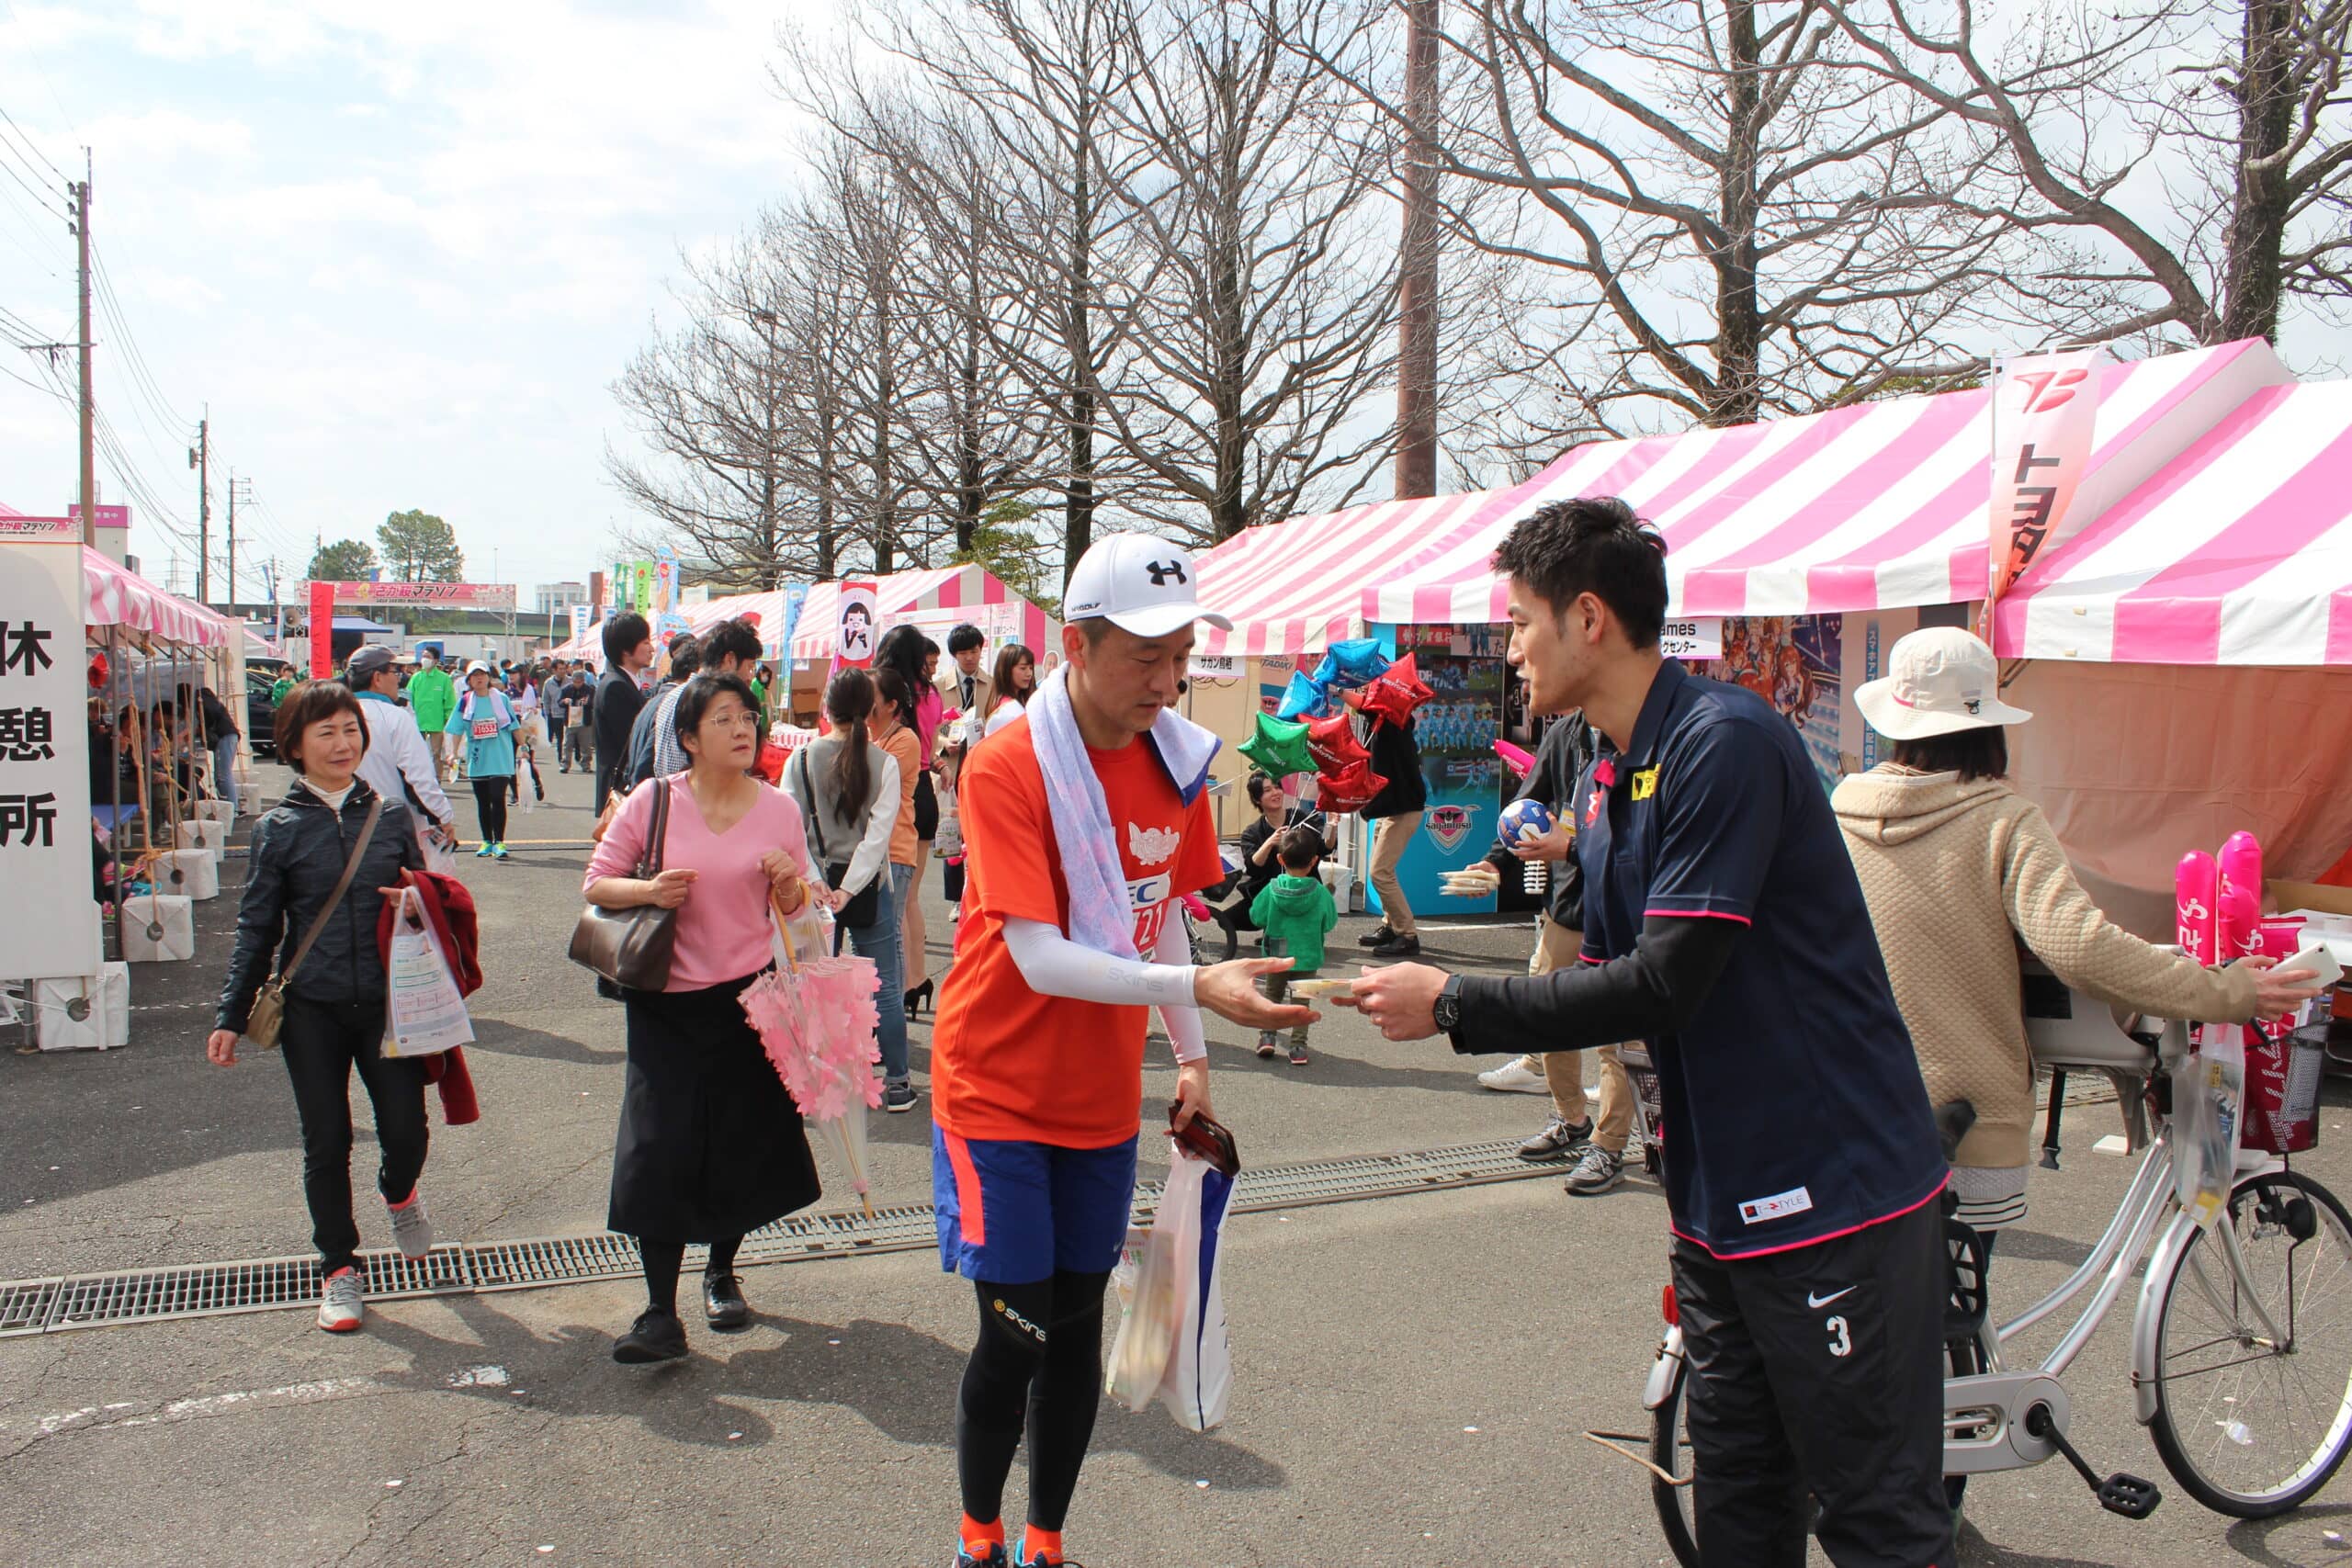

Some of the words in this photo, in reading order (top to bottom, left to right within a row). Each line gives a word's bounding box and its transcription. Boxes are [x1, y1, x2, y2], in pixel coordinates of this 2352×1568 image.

[1201, 656, 1232, 670] サガン鳥栖
[0, 621, 57, 847] 休憩所
[1826, 1314, 1852, 1357] 3
